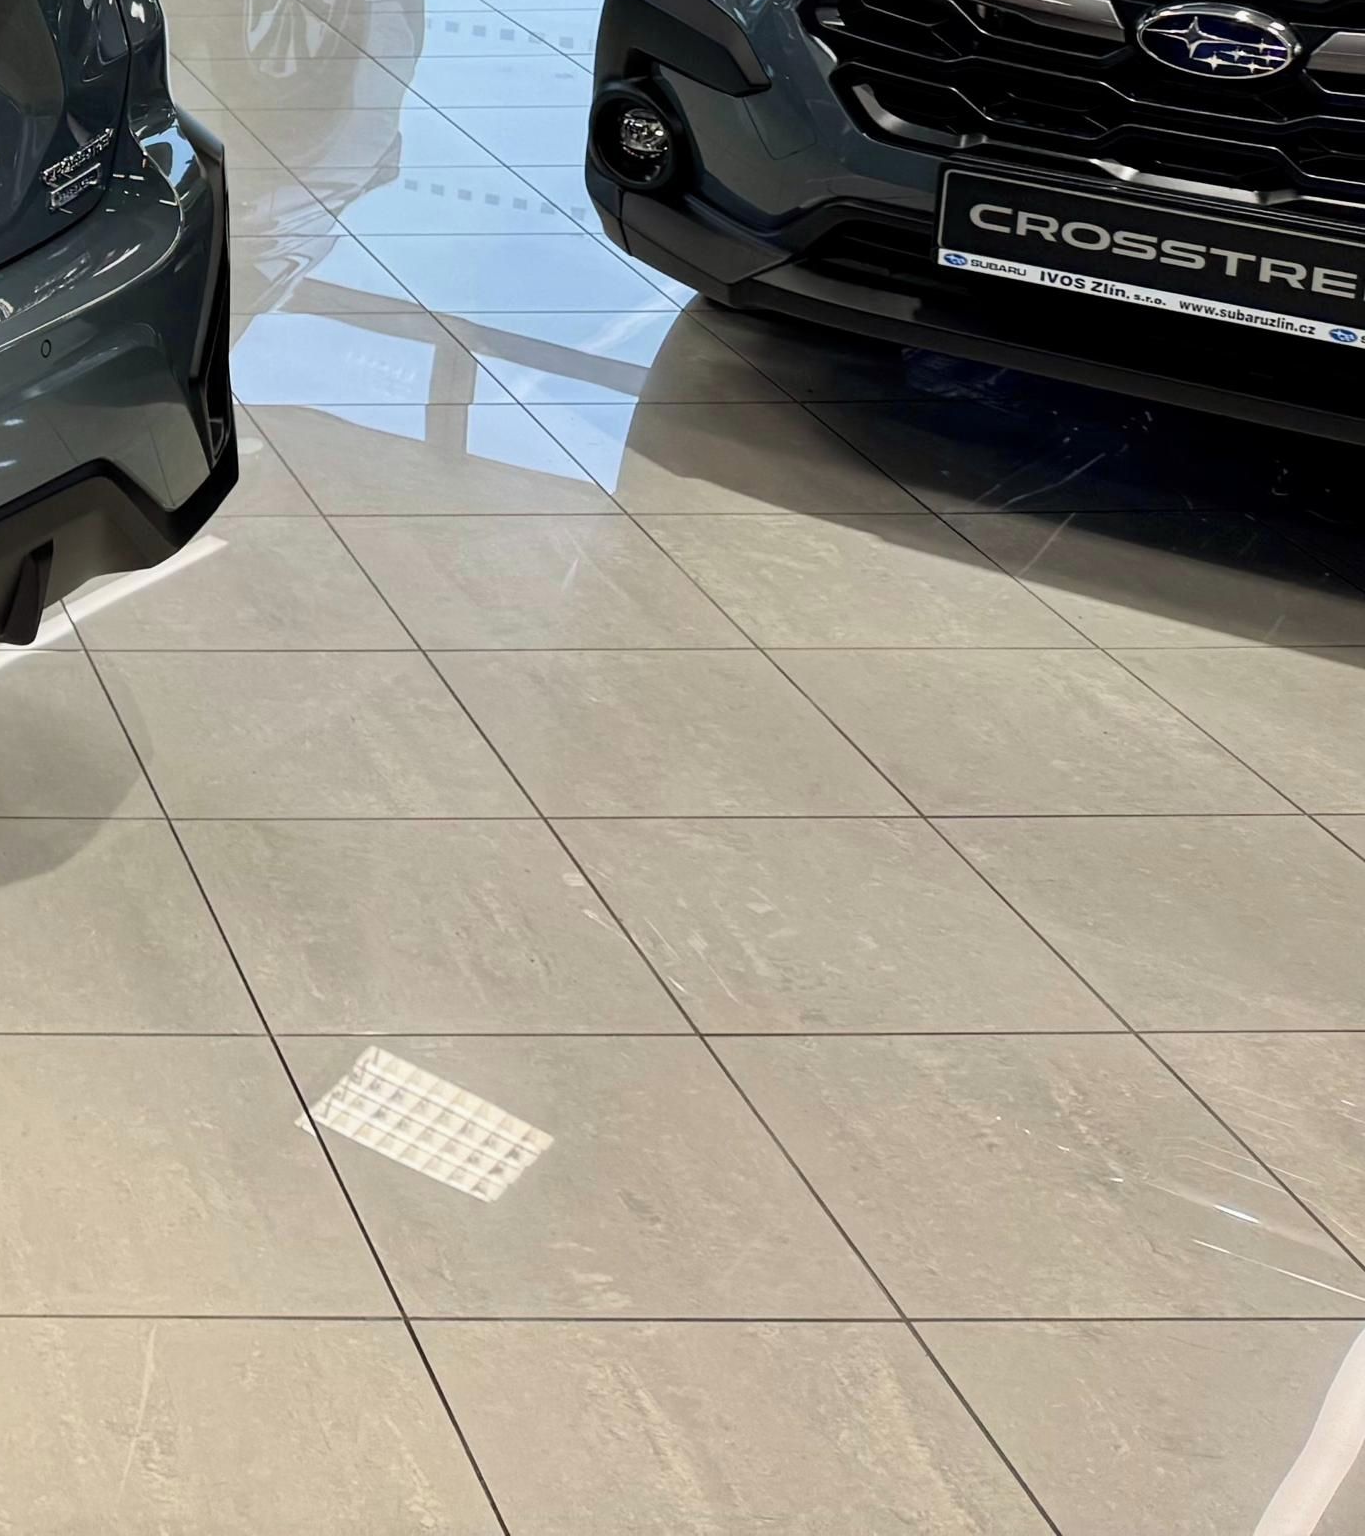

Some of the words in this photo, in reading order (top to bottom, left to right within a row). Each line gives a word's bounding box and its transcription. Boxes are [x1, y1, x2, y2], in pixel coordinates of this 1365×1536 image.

[969, 203, 1365, 300] CROSSTRE
[970, 259, 1026, 276] SUBARU
[1040, 270, 1086, 290] IVOS
[1133, 293, 1167, 306] s.r.o.
[1179, 300, 1316, 336] www.subaruzlin.cz
